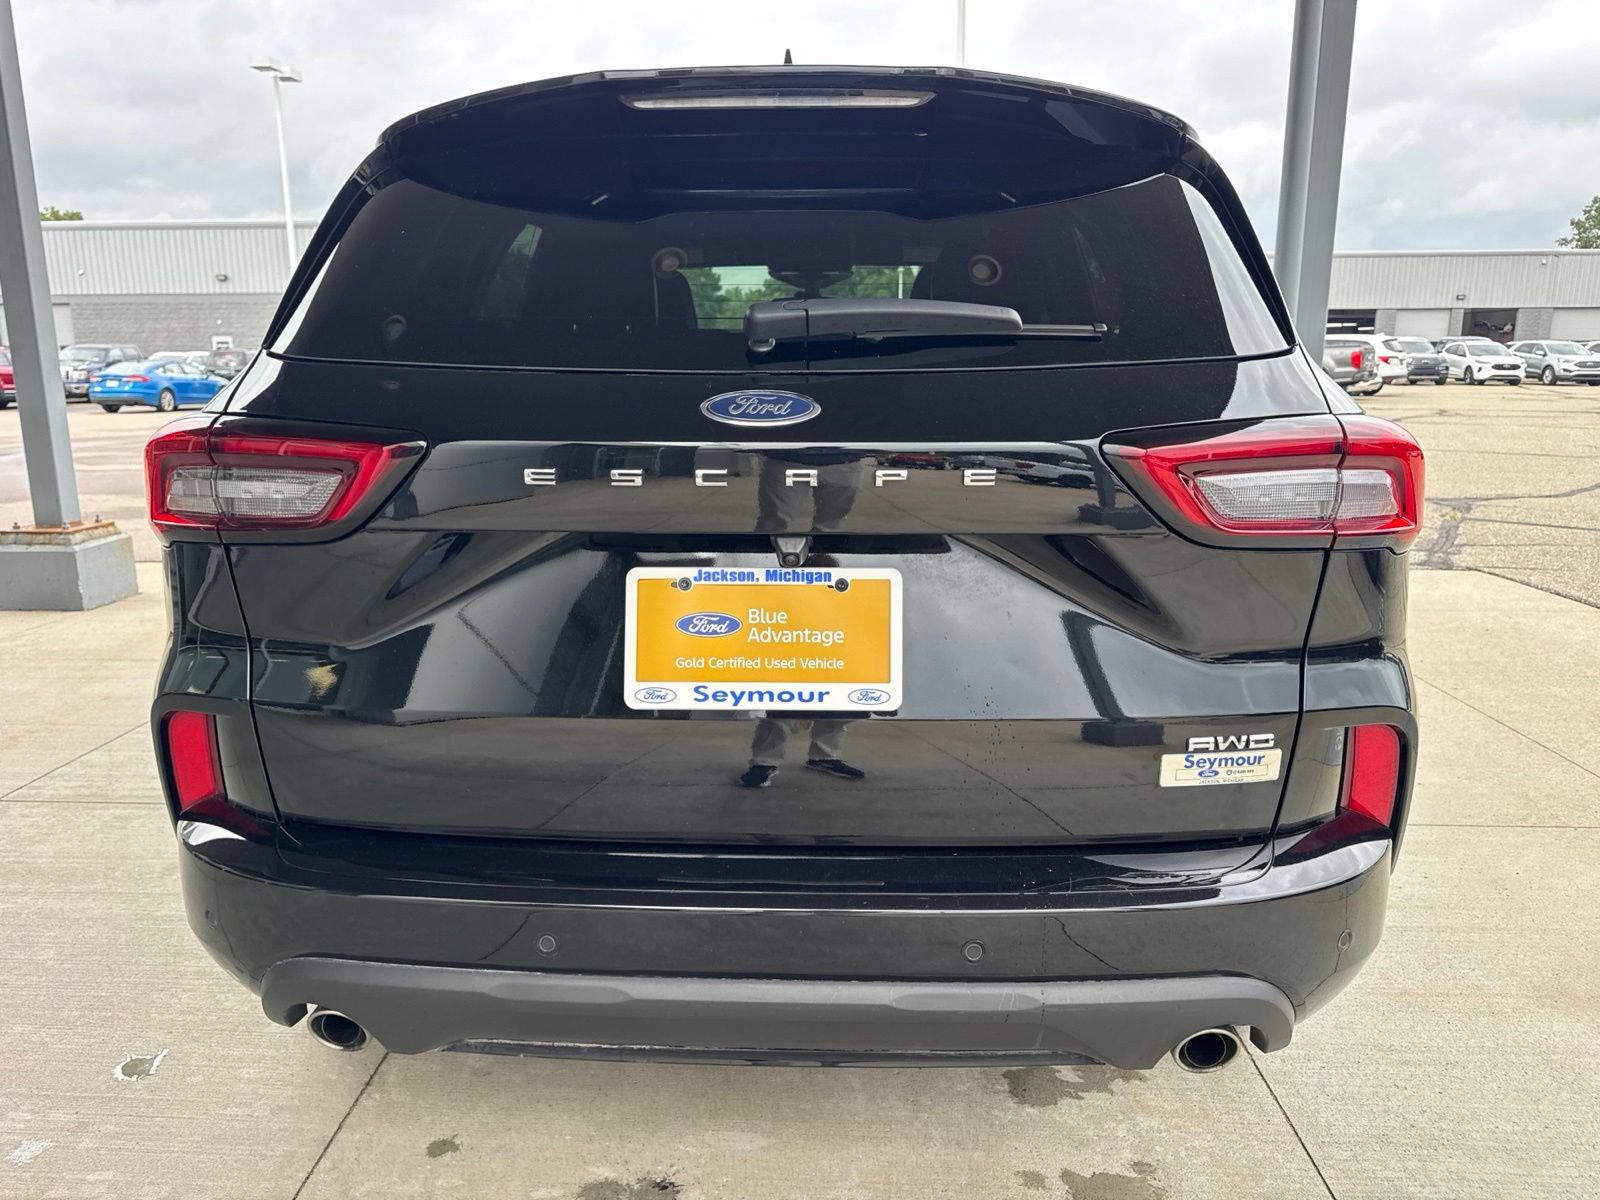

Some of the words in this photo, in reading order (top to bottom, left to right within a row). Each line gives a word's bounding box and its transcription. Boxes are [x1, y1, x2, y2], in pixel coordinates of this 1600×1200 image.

[728, 395, 793, 415] Ford
[523, 468, 997, 487] ESCAPE
[693, 569, 760, 583] Jackson,
[765, 569, 832, 584] Michigan
[688, 615, 731, 634] Ford
[748, 608, 788, 625] Blue
[747, 627, 845, 646] Advantage
[675, 656, 705, 669] Gold
[708, 656, 761, 669] Certified
[764, 657, 796, 669] Used
[799, 657, 845, 670] Vehicle
[642, 689, 669, 701] Ford
[692, 685, 830, 706] Seymour
[856, 690, 884, 703] Ford
[1187, 733, 1275, 751] AWD
[1184, 754, 1265, 770] Seymour
